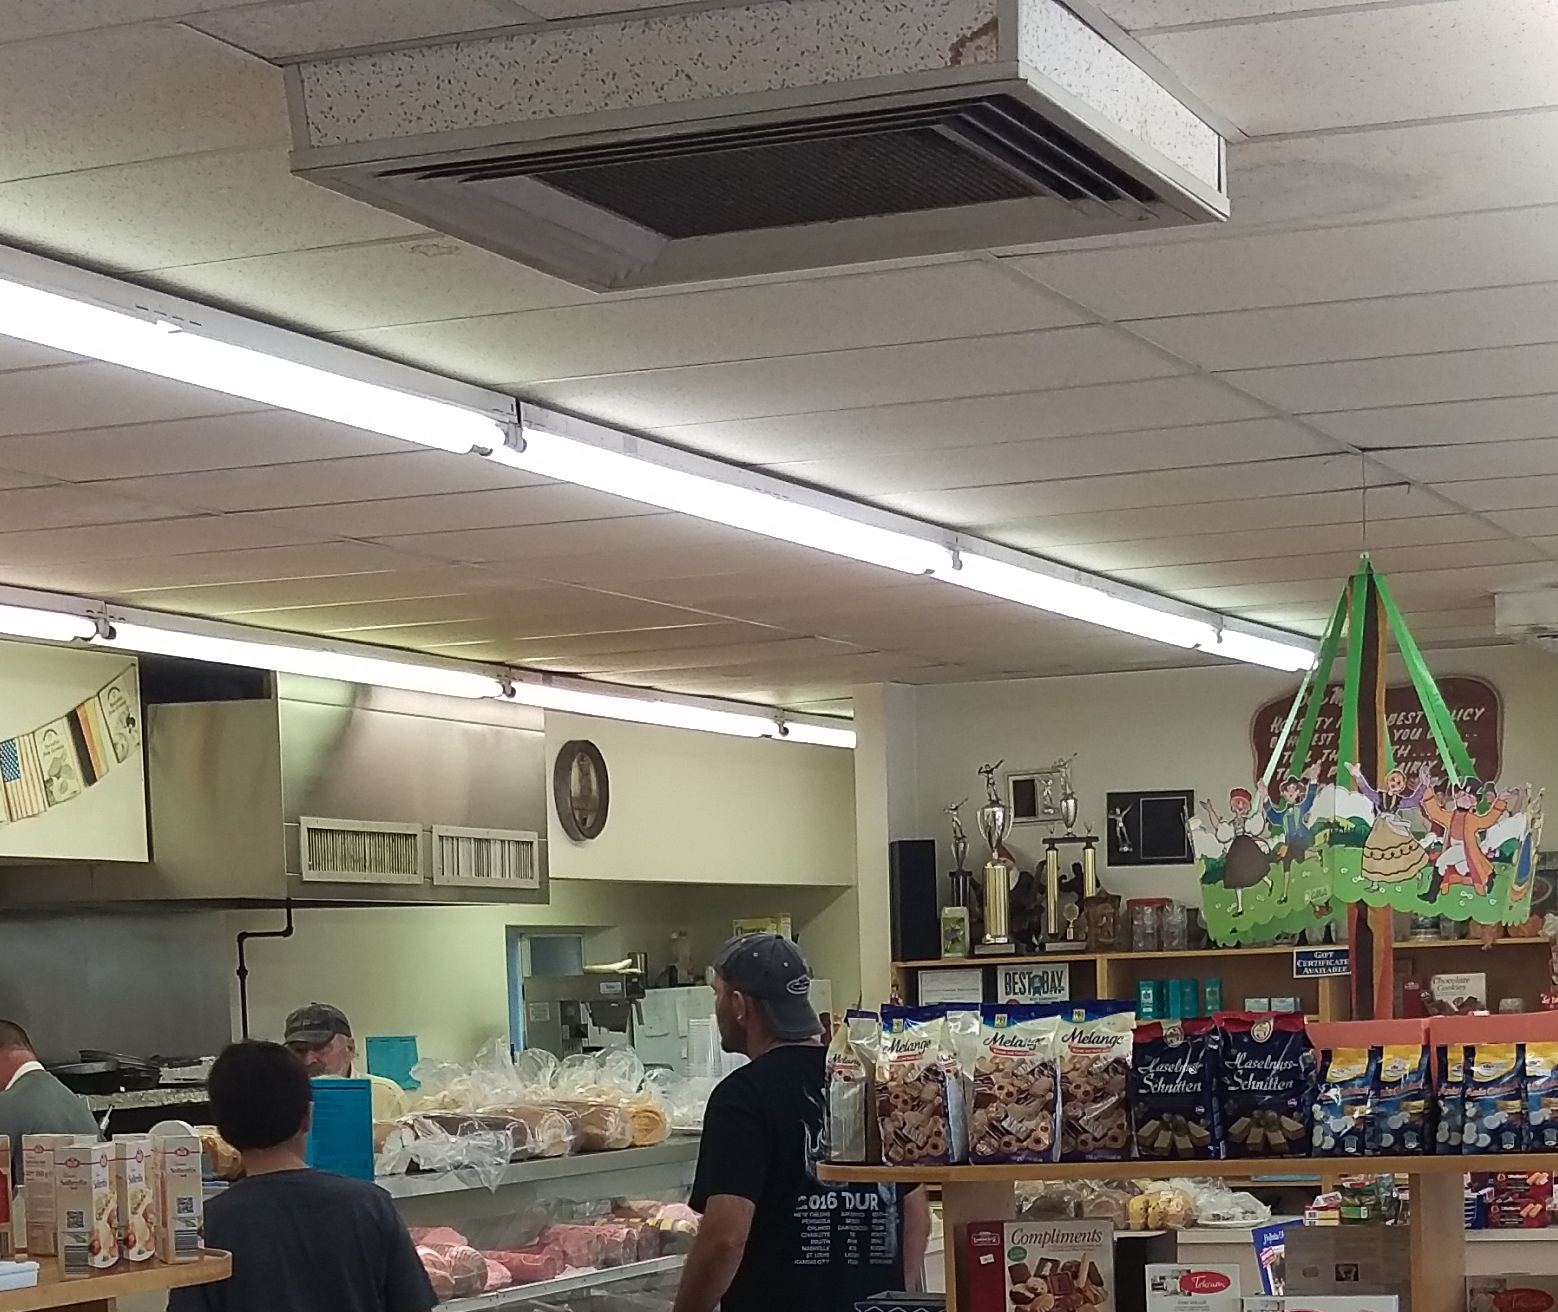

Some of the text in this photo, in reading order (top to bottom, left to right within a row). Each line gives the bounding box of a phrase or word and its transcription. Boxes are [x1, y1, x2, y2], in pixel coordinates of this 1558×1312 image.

[1393, 727, 1423, 742] YOU
[1303, 966, 1348, 975] AVAILABLE
[1005, 972, 1037, 996] BEST
[886, 1038, 932, 1056] Melange
[1061, 1030, 1124, 1051] Melange
[1224, 1051, 1299, 1071] Haselnuss-
[1137, 1072, 1203, 1094] Schnitten
[1227, 1069, 1293, 1092] Schnitten
[795, 1191, 838, 1211] 2016
[1011, 1227, 1104, 1247] Compliments
